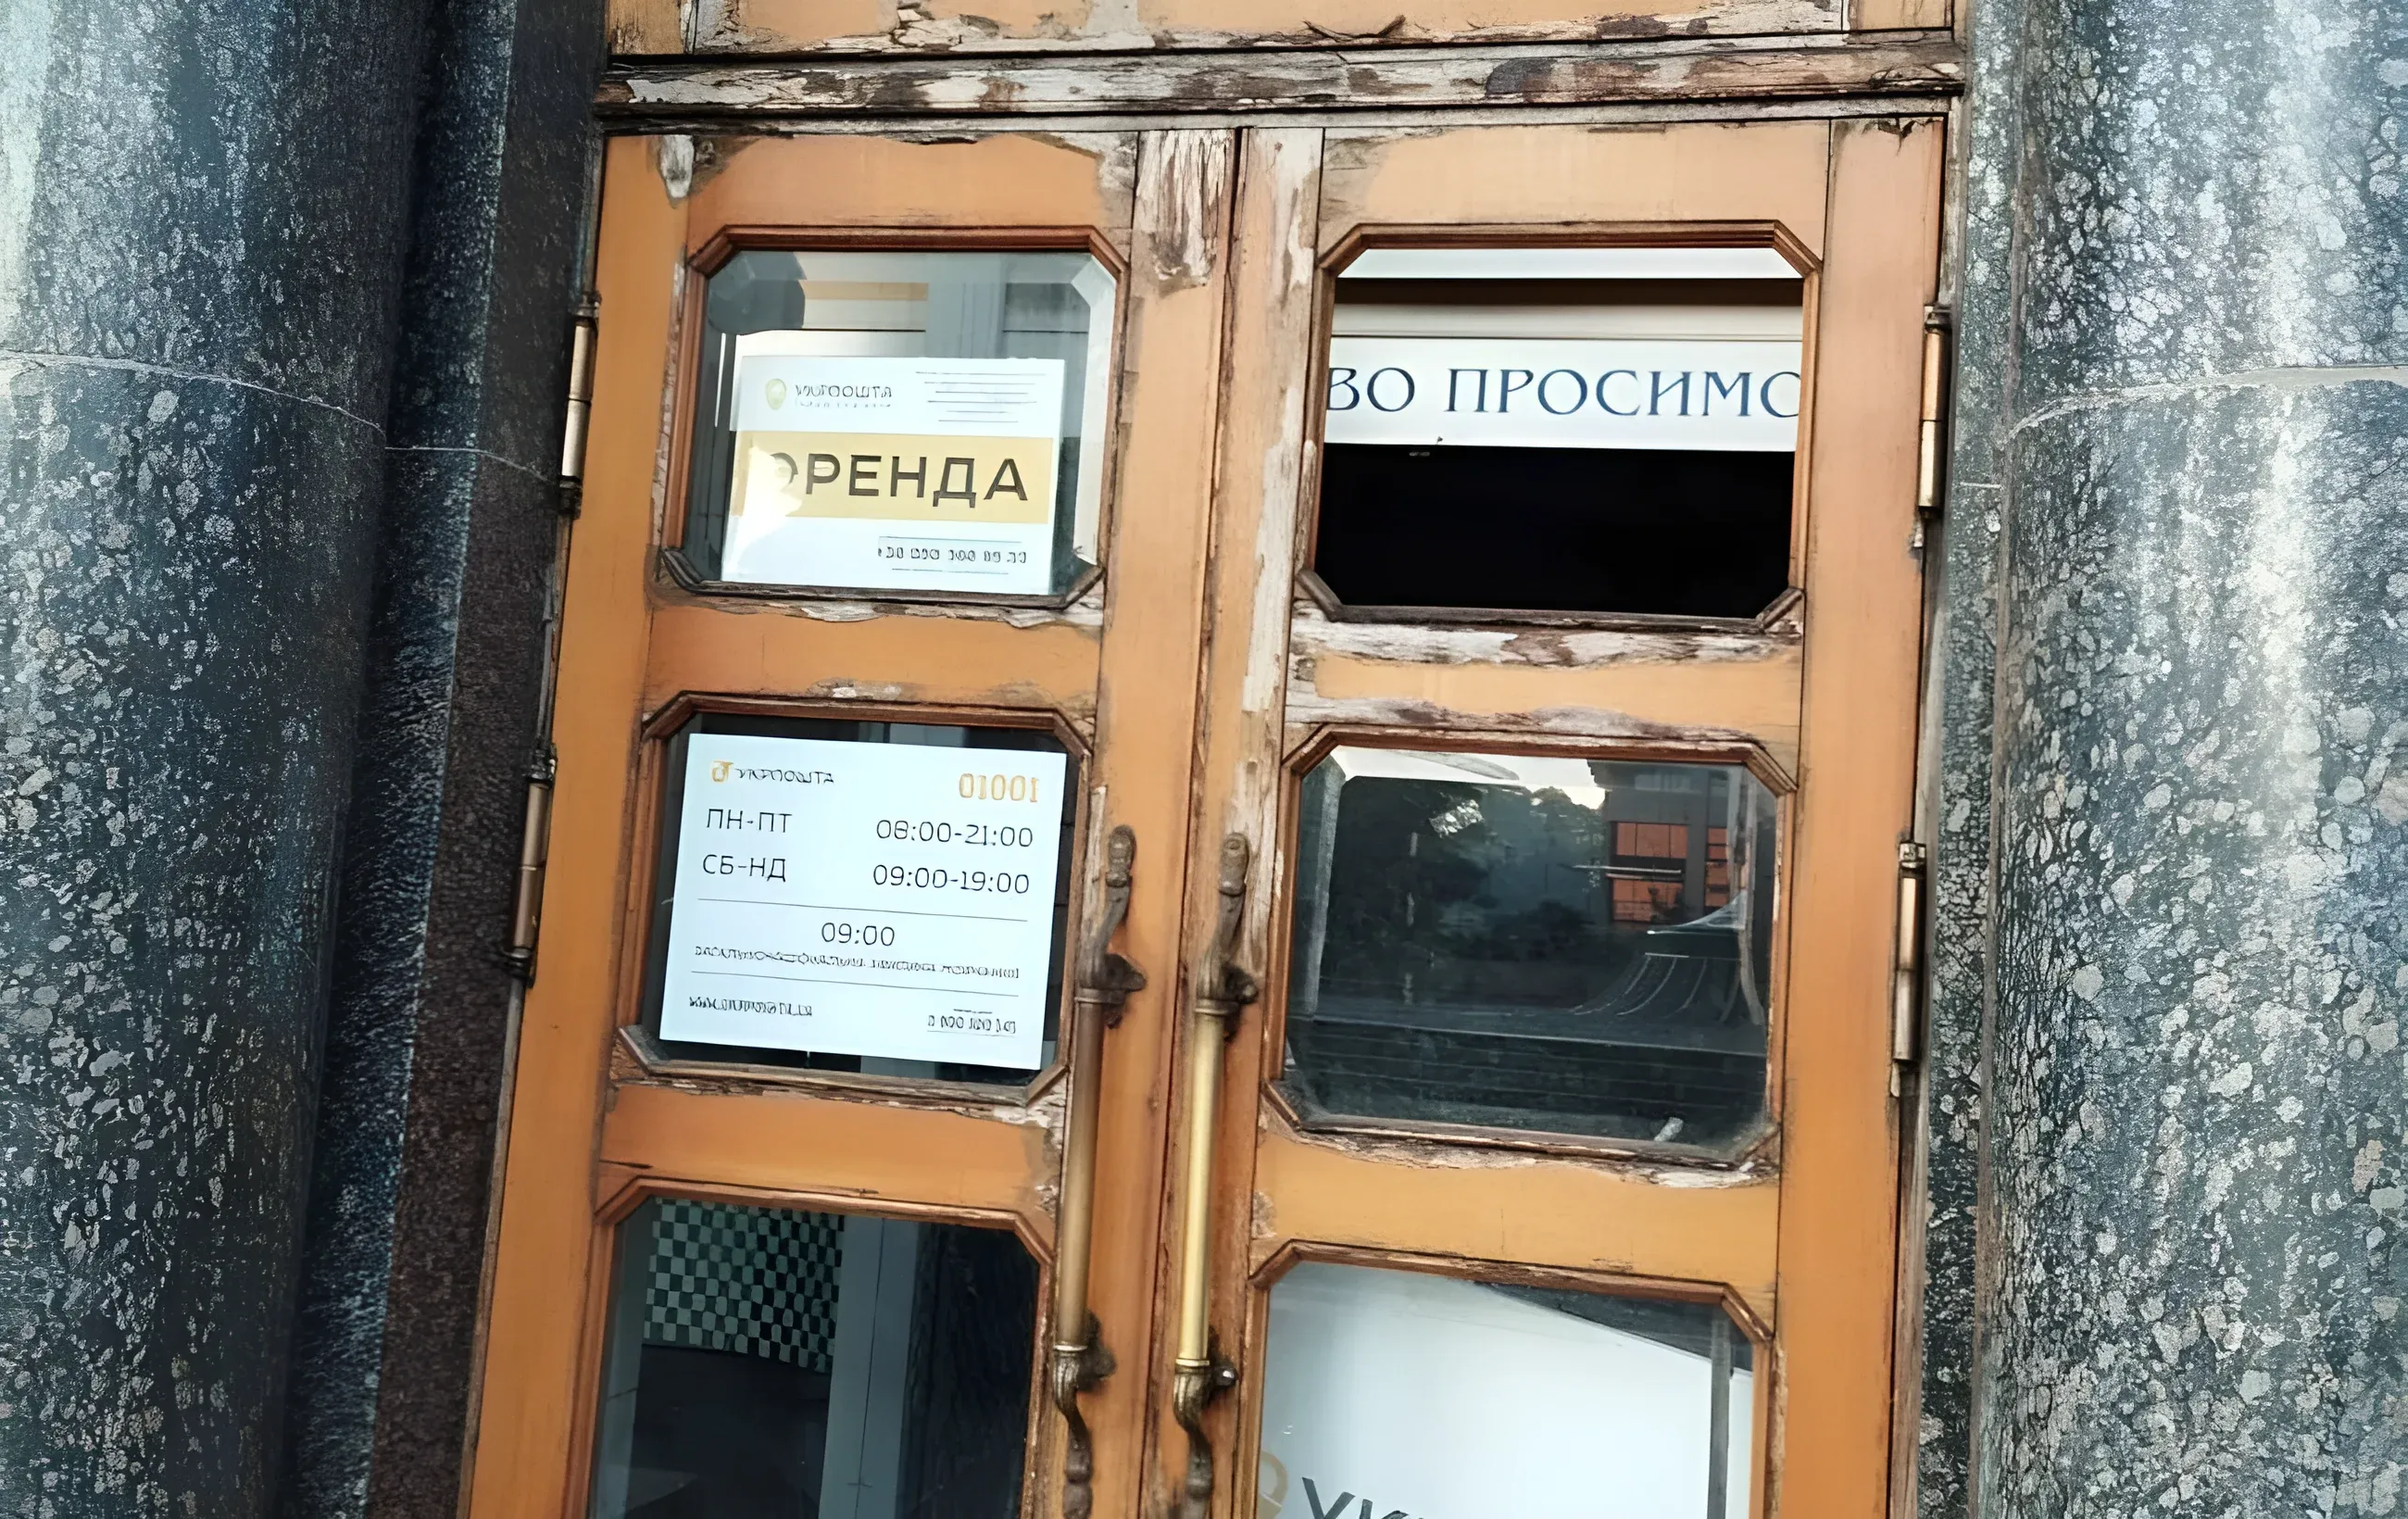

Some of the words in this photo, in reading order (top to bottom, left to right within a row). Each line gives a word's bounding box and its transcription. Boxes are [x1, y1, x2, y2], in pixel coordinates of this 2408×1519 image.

[1326, 366, 1416, 413] ВО
[959, 772, 1039, 803] 01001
[706, 808, 793, 834] ПН-ПТ
[876, 819, 1034, 847] 08:00-21:00
[702, 853, 786, 883] СБ-НД
[872, 864, 1030, 894] 09:00-19:00
[821, 922, 896, 947] 09:00
